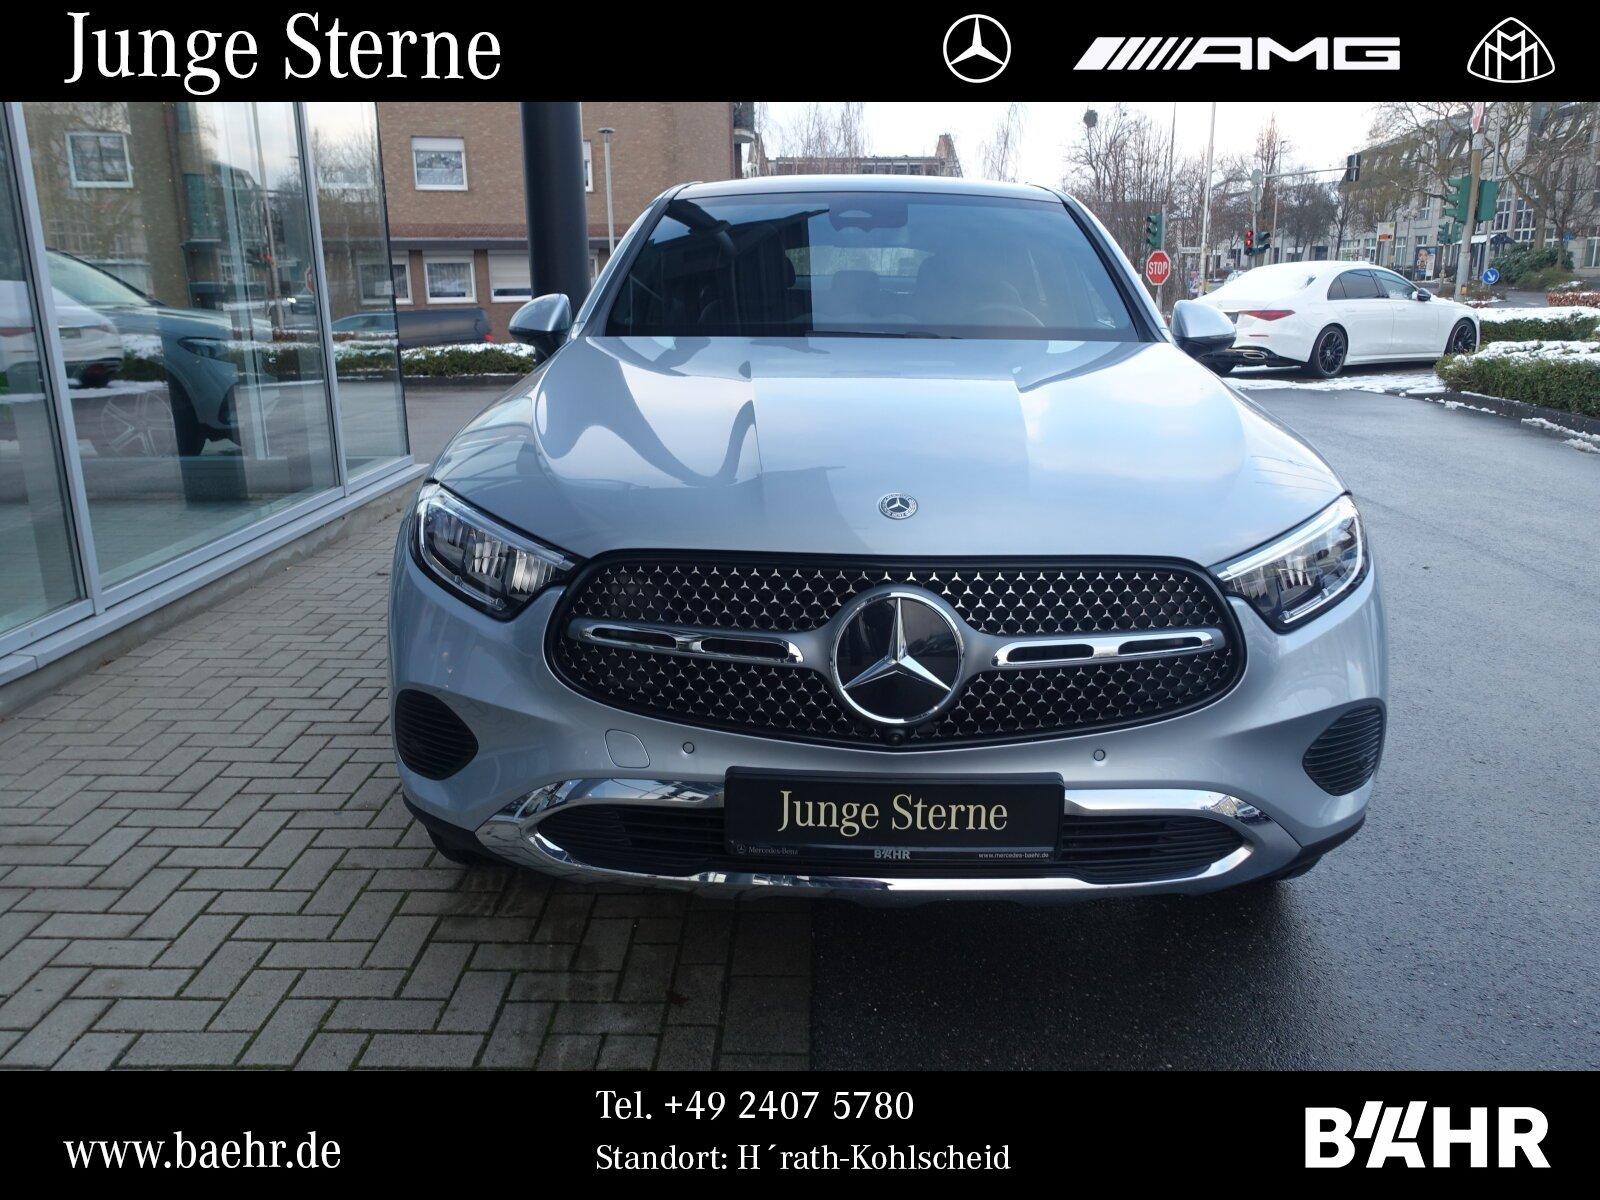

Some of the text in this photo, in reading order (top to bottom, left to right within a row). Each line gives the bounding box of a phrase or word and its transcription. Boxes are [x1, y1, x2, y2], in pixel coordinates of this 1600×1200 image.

[1149, 261, 1168, 275] STOP
[777, 790, 1008, 837] Junge Sterne
[748, 846, 799, 855] Mercedes-Benz
